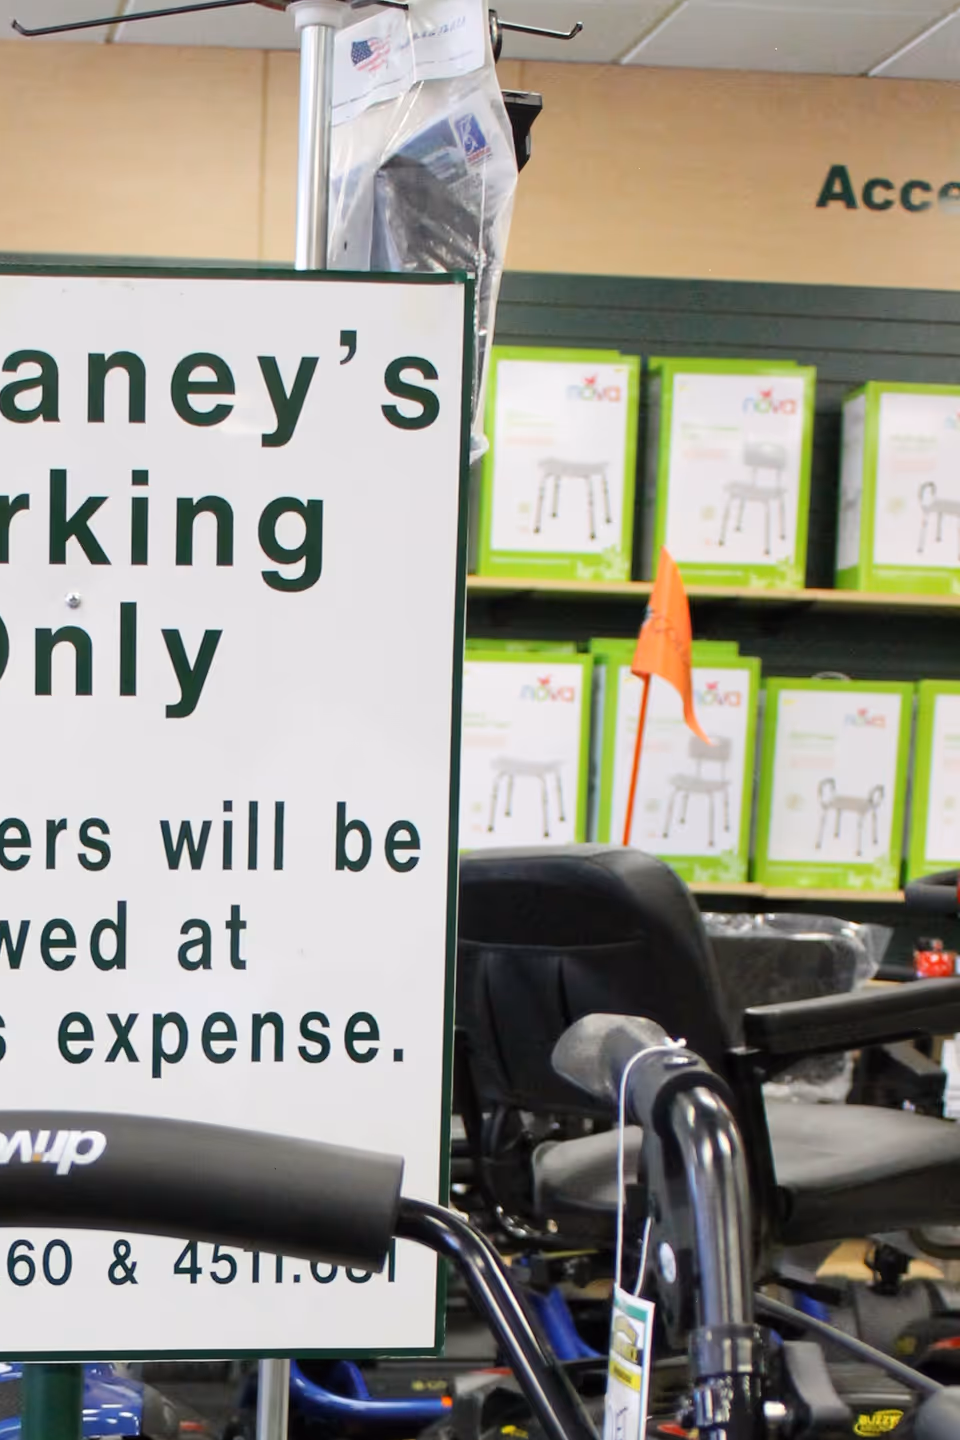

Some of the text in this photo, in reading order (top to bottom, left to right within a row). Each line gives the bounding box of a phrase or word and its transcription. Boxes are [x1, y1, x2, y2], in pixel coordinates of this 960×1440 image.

[742, 395, 798, 416] nova
[519, 681, 575, 703] nova
[159, 800, 286, 871] will
[335, 801, 422, 873] be
[177, 904, 248, 971] at
[57, 1011, 406, 1079] expense.
[107, 1239, 138, 1285] &
